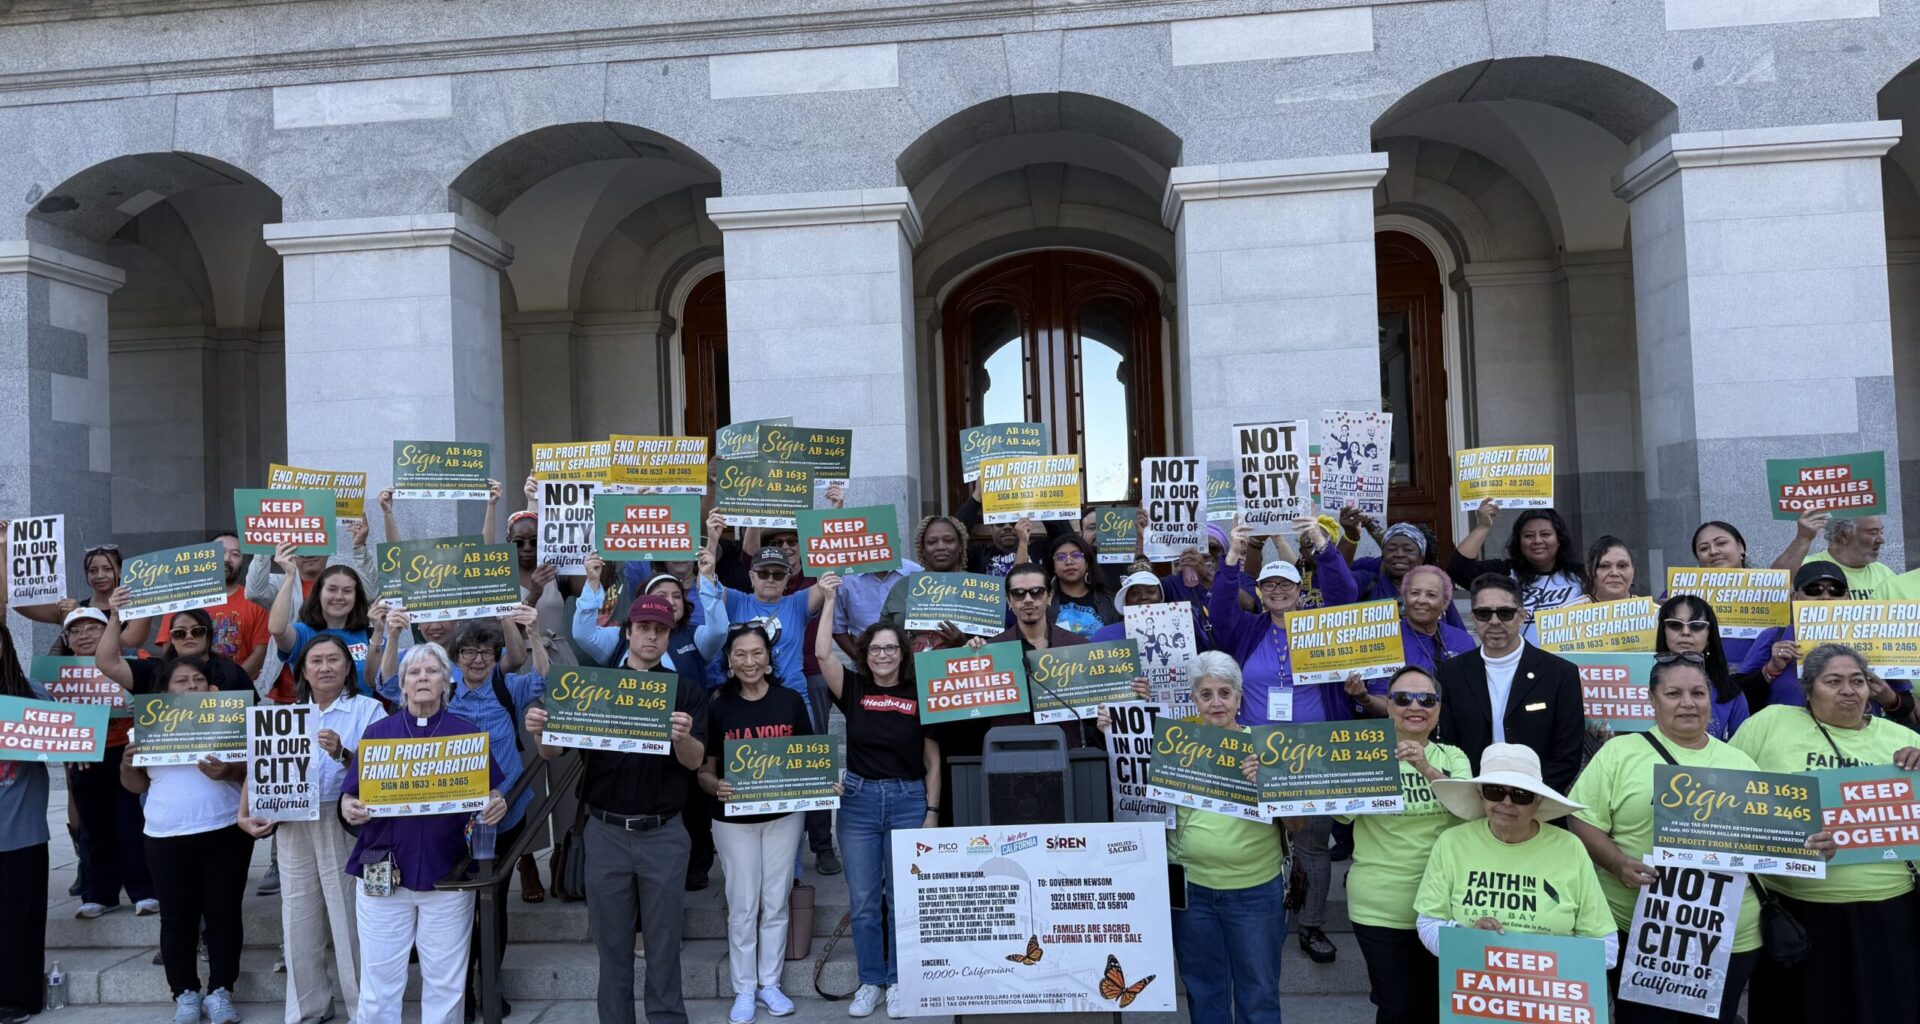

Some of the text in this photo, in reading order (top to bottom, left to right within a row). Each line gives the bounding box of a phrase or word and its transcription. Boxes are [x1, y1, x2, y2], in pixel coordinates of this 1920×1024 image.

[1240, 426, 1297, 455] NOT
[1242, 454, 1299, 473] IN OUR
[1801, 468, 1848, 481] KEEP
[1243, 472, 1300, 499] CITY
[1784, 481, 1868, 496] FAMILIES
[262, 502, 302, 512] KEEP
[1245, 498, 1300, 509] ICE OUT OF
[1779, 495, 1874, 510] TOGETHER
[627, 509, 669, 519] KEEP
[14, 518, 57, 542] NOT
[248, 518, 321, 529] FAMILIES
[611, 524, 686, 534] FAMILIES
[823, 520, 864, 533] KEEP
[245, 532, 325, 543] TOGETHER
[604, 538, 690, 548] TOGETHER
[811, 535, 885, 550] FAMILIES
[14, 541, 57, 557] IN OUR
[808, 548, 890, 565] TOGETHER
[13, 555, 58, 578] CITY
[14, 575, 57, 586] ICE OUT OF
[14, 586, 58, 599] California
[1291, 604, 1395, 634] END PROFIT FROM
[1291, 621, 1400, 650] FAMILY SEPARATION
[948, 659, 990, 673] KEEP
[618, 678, 667, 694] AB 1633
[933, 673, 1011, 693] FAMILIES
[552, 672, 614, 712] Sign
[928, 688, 1017, 709] TOGETHER
[615, 695, 666, 710] AB 2465
[255, 708, 310, 737] NOT
[1330, 730, 1384, 743] AB 1633
[255, 738, 311, 756] IN OUR
[364, 736, 485, 763] END PROFIT FROM
[1261, 731, 1328, 773] Sign
[1330, 749, 1388, 762] AB 2465
[255, 757, 310, 784] CITY
[361, 755, 489, 780] FAMILY SEPARATION
[256, 783, 309, 794] ICE OUT OF
[381, 777, 469, 791] SIGN AB 1633 AB 2465
[1745, 781, 1808, 800] AB 1633
[256, 797, 309, 812] California
[1661, 773, 1742, 821] Sign
[1743, 801, 1811, 821] AB 2465
[1002, 836, 1038, 854] CALIFORNIA
[1109, 845, 1138, 854] SACRED
[1678, 838, 1707, 846] PROFIT
[1709, 840, 1732, 848] FROM
[1734, 843, 1765, 851] FAMILY
[1767, 846, 1819, 856] SEPARATION
[932, 872, 959, 880] GOVERNOR
[960, 871, 986, 879] NEWSOM,
[1038, 878, 1112, 887] TO: GOVERNOR NEWSOM
[1468, 871, 1536, 891] FAITH IN
[1649, 866, 1734, 907] NOT
[1073, 893, 1097, 902] STREET,
[1462, 889, 1537, 912] ACTION
[1051, 902, 1095, 911] SACRAMENTO,
[1464, 909, 1536, 921] EAST BAY
[1644, 898, 1725, 933] IN OUR
[1053, 924, 1130, 934] FAMILIES ARE SACRED
[1043, 934, 1142, 943] CALIFORNIA IS NOT FOR SALE
[1638, 922, 1721, 966] CITY
[921, 959, 951, 967] SINCERELY,
[1488, 951, 1554, 971] KEEP
[1636, 955, 1712, 980] ICE OUT OF
[922, 967, 1014, 981] 10,000+ Californians
[1462, 973, 1583, 1001] FAMILIES
[1632, 971, 1707, 999] California
[1453, 994, 1591, 1024] TOGETHER
